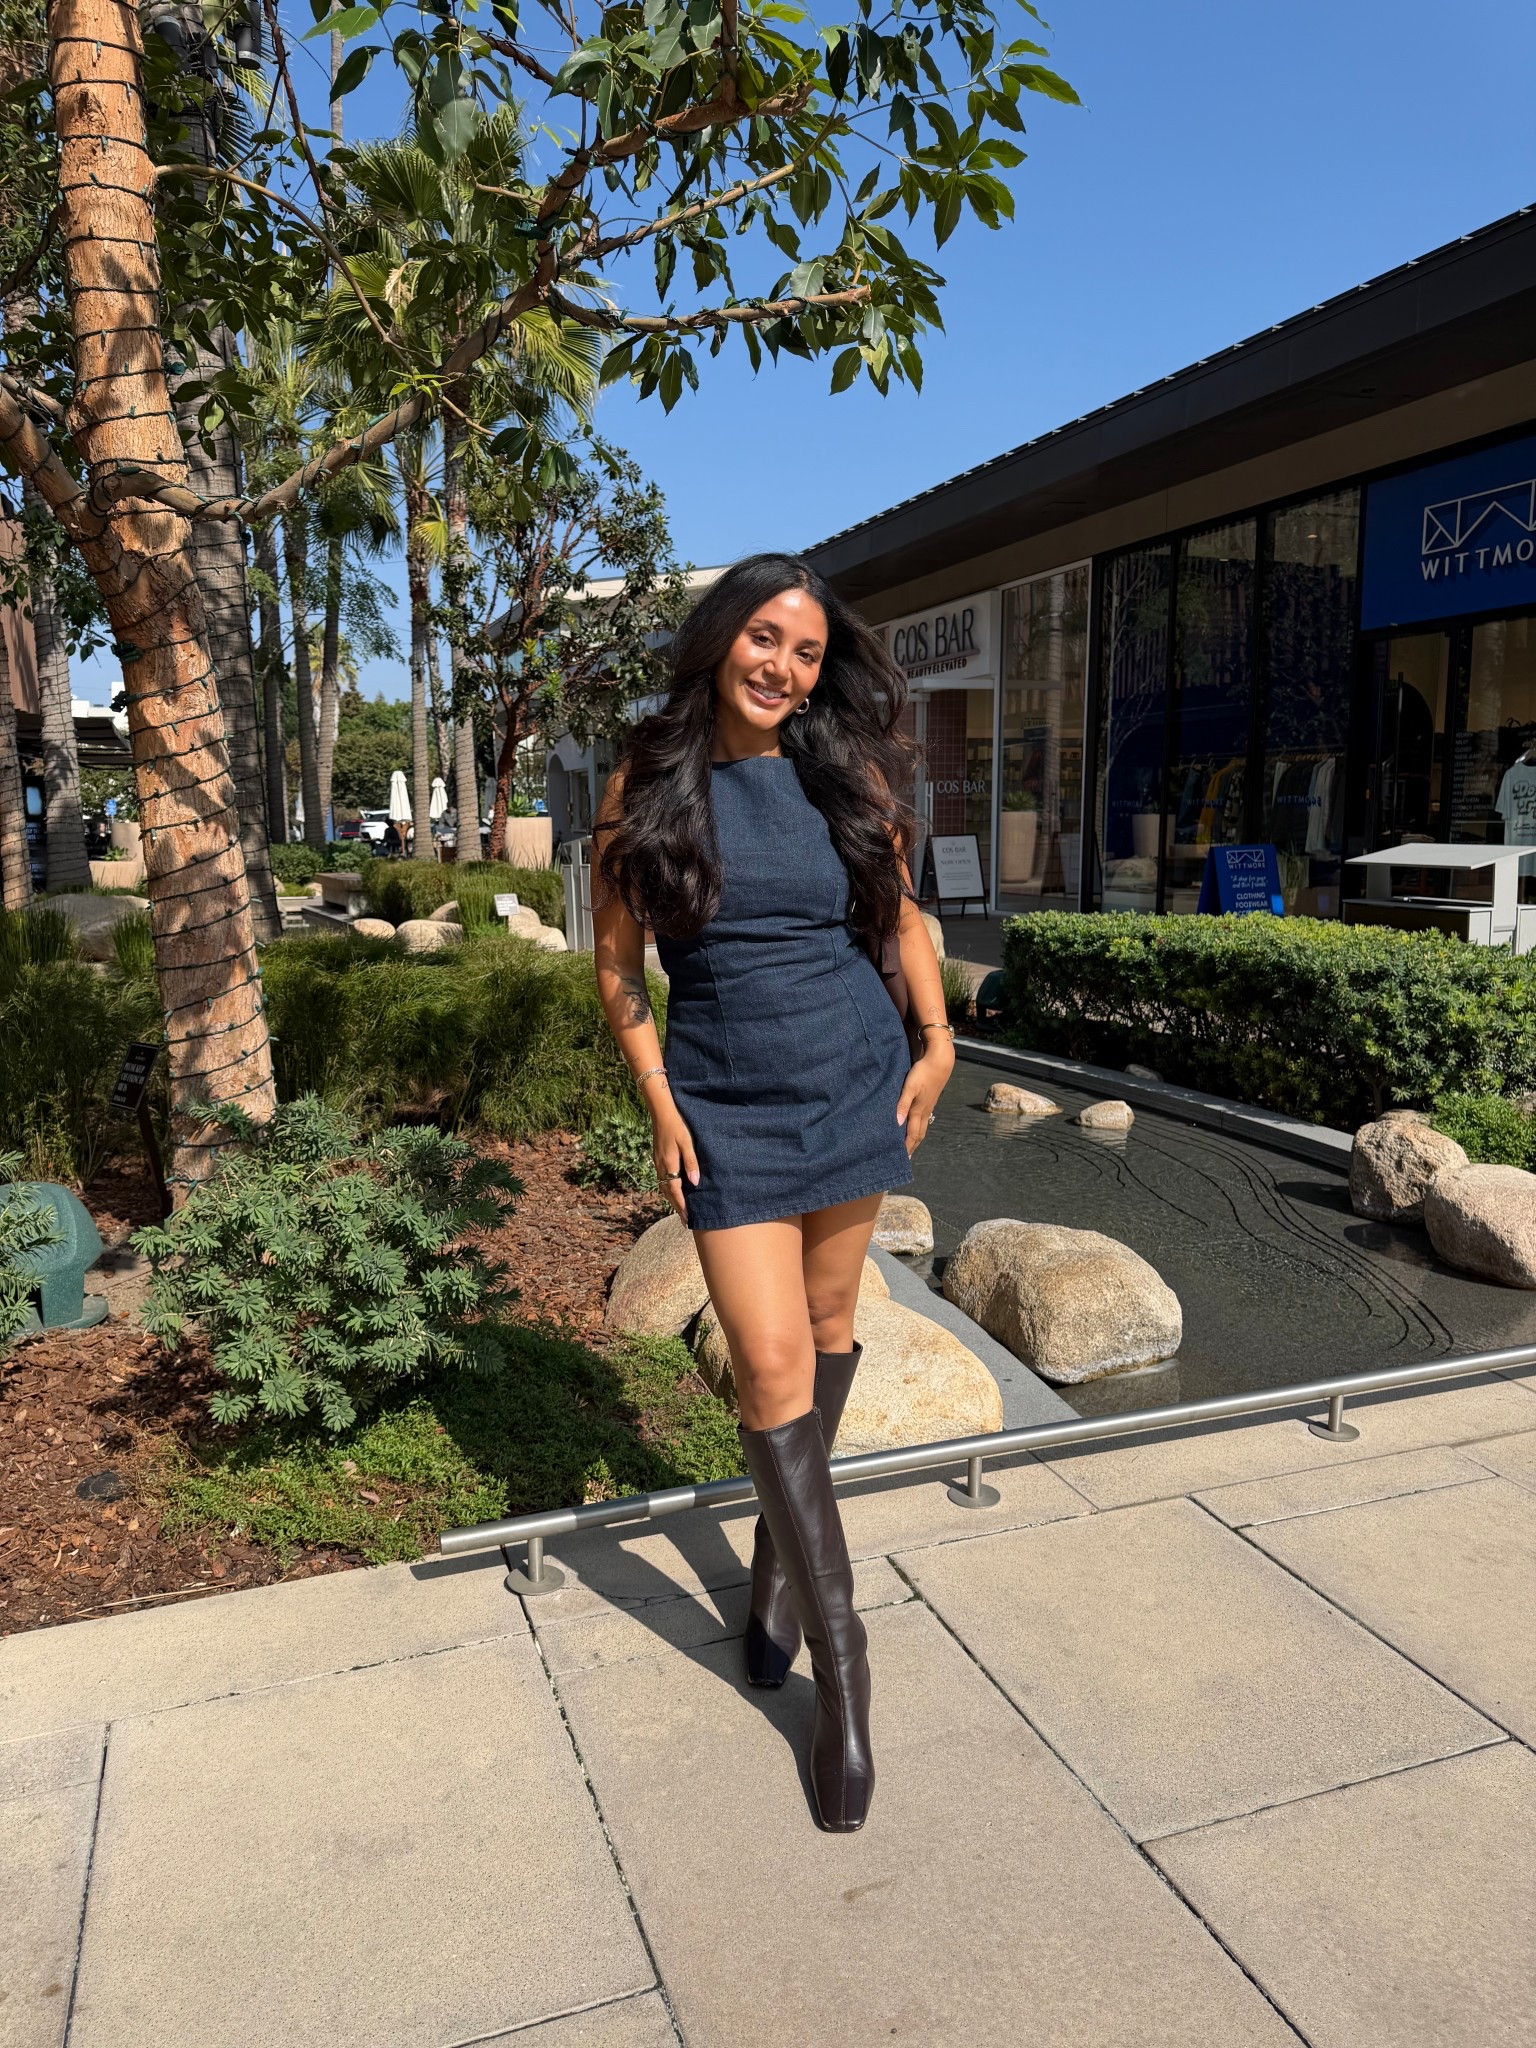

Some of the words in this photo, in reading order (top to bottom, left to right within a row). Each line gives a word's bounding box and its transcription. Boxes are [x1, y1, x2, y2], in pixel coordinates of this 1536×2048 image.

[894, 622, 928, 666] COS
[935, 609, 974, 657] BAR
[907, 667, 932, 679] BEAUTY
[933, 659, 967, 673] ELEVATED
[937, 780, 960, 794] COS
[963, 780, 986, 793] BAR
[1278, 794, 1322, 807] WITTMORE
[1236, 892, 1265, 900] CLOTHING
